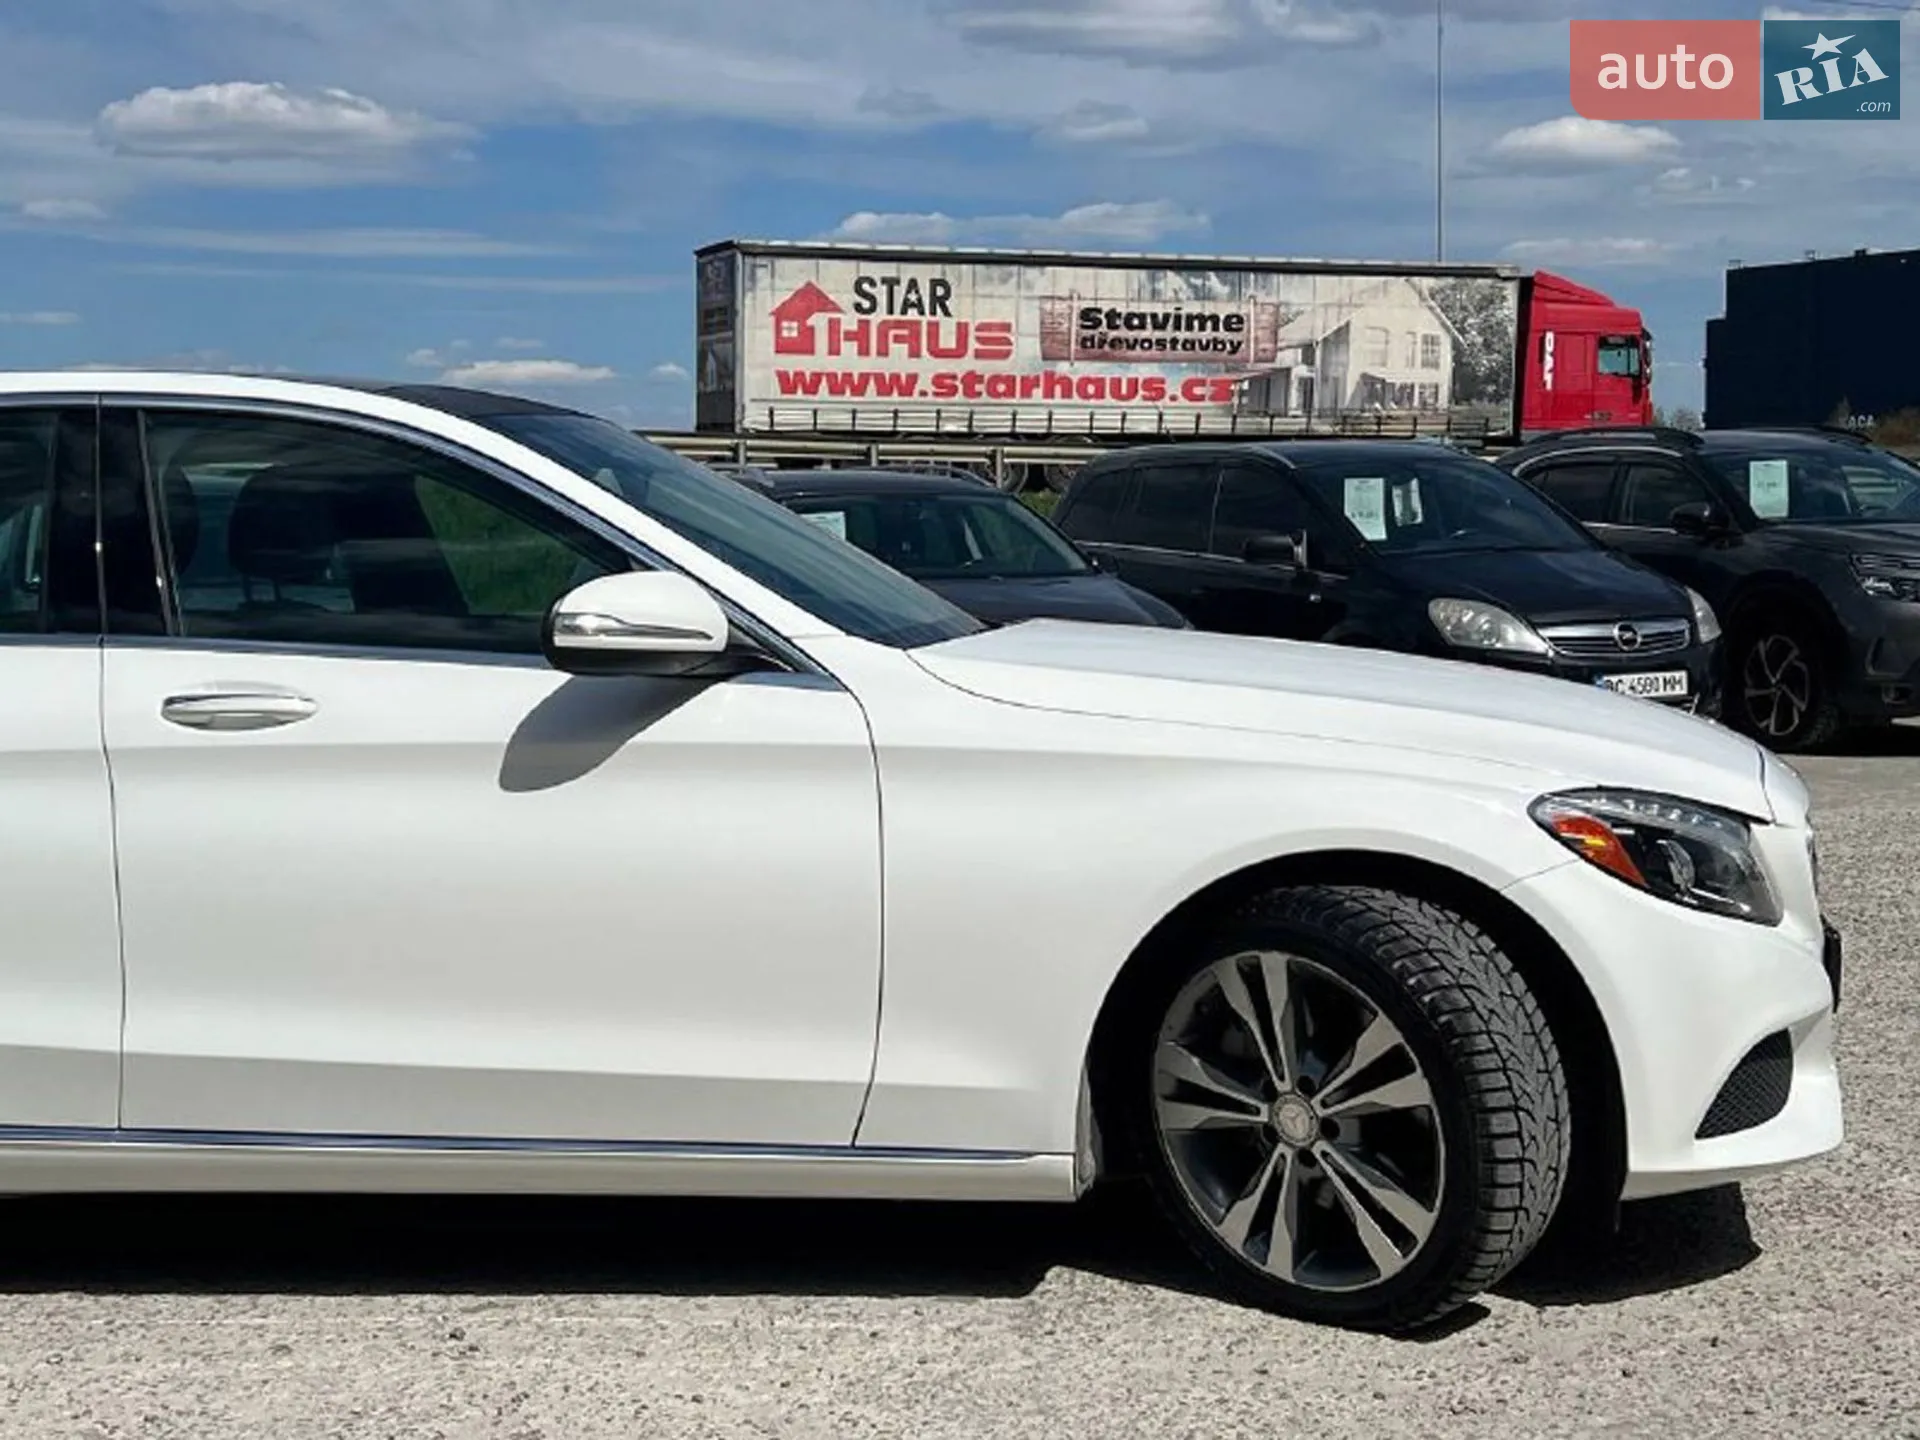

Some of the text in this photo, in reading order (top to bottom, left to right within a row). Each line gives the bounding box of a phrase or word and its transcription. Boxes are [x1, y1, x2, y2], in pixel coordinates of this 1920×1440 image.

[853, 275, 954, 317] STAR
[828, 317, 1014, 360] HAUS
[776, 369, 1233, 405] www.starhaus.cz
